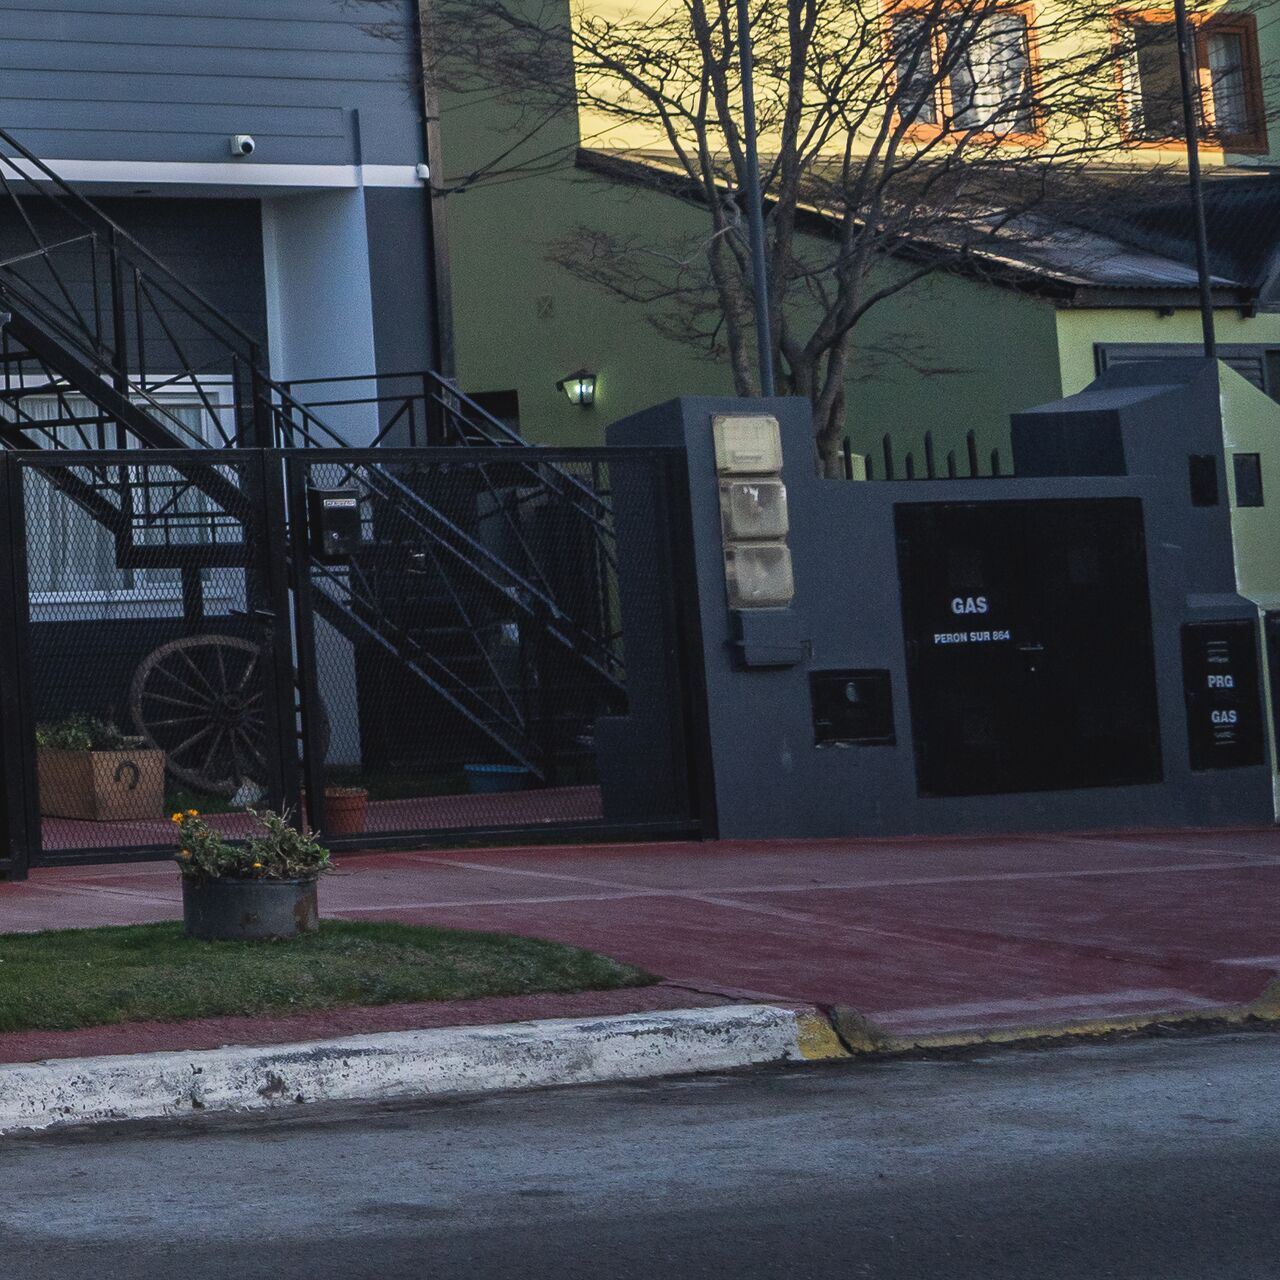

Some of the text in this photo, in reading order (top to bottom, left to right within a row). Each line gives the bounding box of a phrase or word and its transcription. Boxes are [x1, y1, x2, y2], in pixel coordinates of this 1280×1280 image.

[951, 596, 988, 614] GAS
[934, 630, 1010, 644] PERON SUR 864
[1207, 675, 1234, 688] PRG
[1211, 710, 1237, 723] GAS
